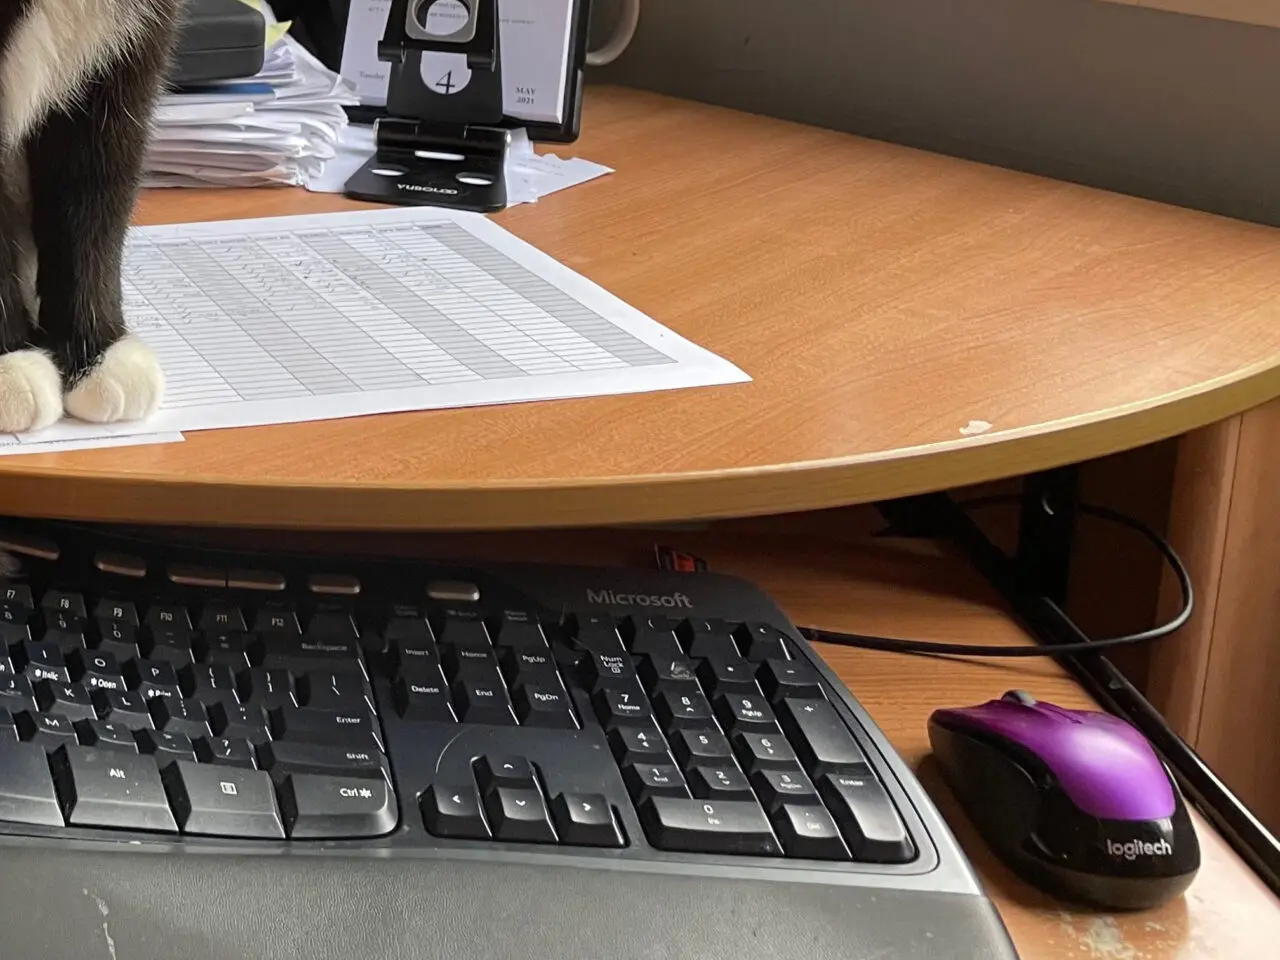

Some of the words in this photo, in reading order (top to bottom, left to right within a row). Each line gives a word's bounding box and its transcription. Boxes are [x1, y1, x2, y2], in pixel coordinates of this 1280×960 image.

[434, 70, 456, 95] 4
[515, 86, 537, 96] MAY
[515, 96, 536, 105] 2021
[6, 590, 16, 599] F7
[586, 588, 694, 609] Microsoft
[60, 599, 70, 609] F8
[113, 608, 123, 618] F9
[160, 611, 173, 622] F10
[215, 614, 229, 623] F11
[271, 617, 285, 628] F12
[521, 654, 546, 663] PgUp
[42, 669, 58, 681] Italic
[151, 667, 160, 677] P
[97, 679, 117, 690] Open
[411, 685, 439, 693] Delete
[475, 689, 493, 697] End
[533, 693, 559, 702] PgDn
[620, 693, 629, 703] 7
[681, 696, 691, 706] 8
[741, 699, 753, 709] 9
[336, 716, 361, 725] Enter
[637, 732, 647, 740] 4
[699, 735, 709, 744] 5
[760, 738, 771, 747] 6
[346, 752, 369, 761] Shift
[109, 767, 126, 779] Alt
[651, 768, 660, 776] 1
[715, 771, 726, 779] 2
[339, 788, 359, 798] Ctrl
[703, 804, 714, 814] 0
[1106, 839, 1173, 860] logitech
